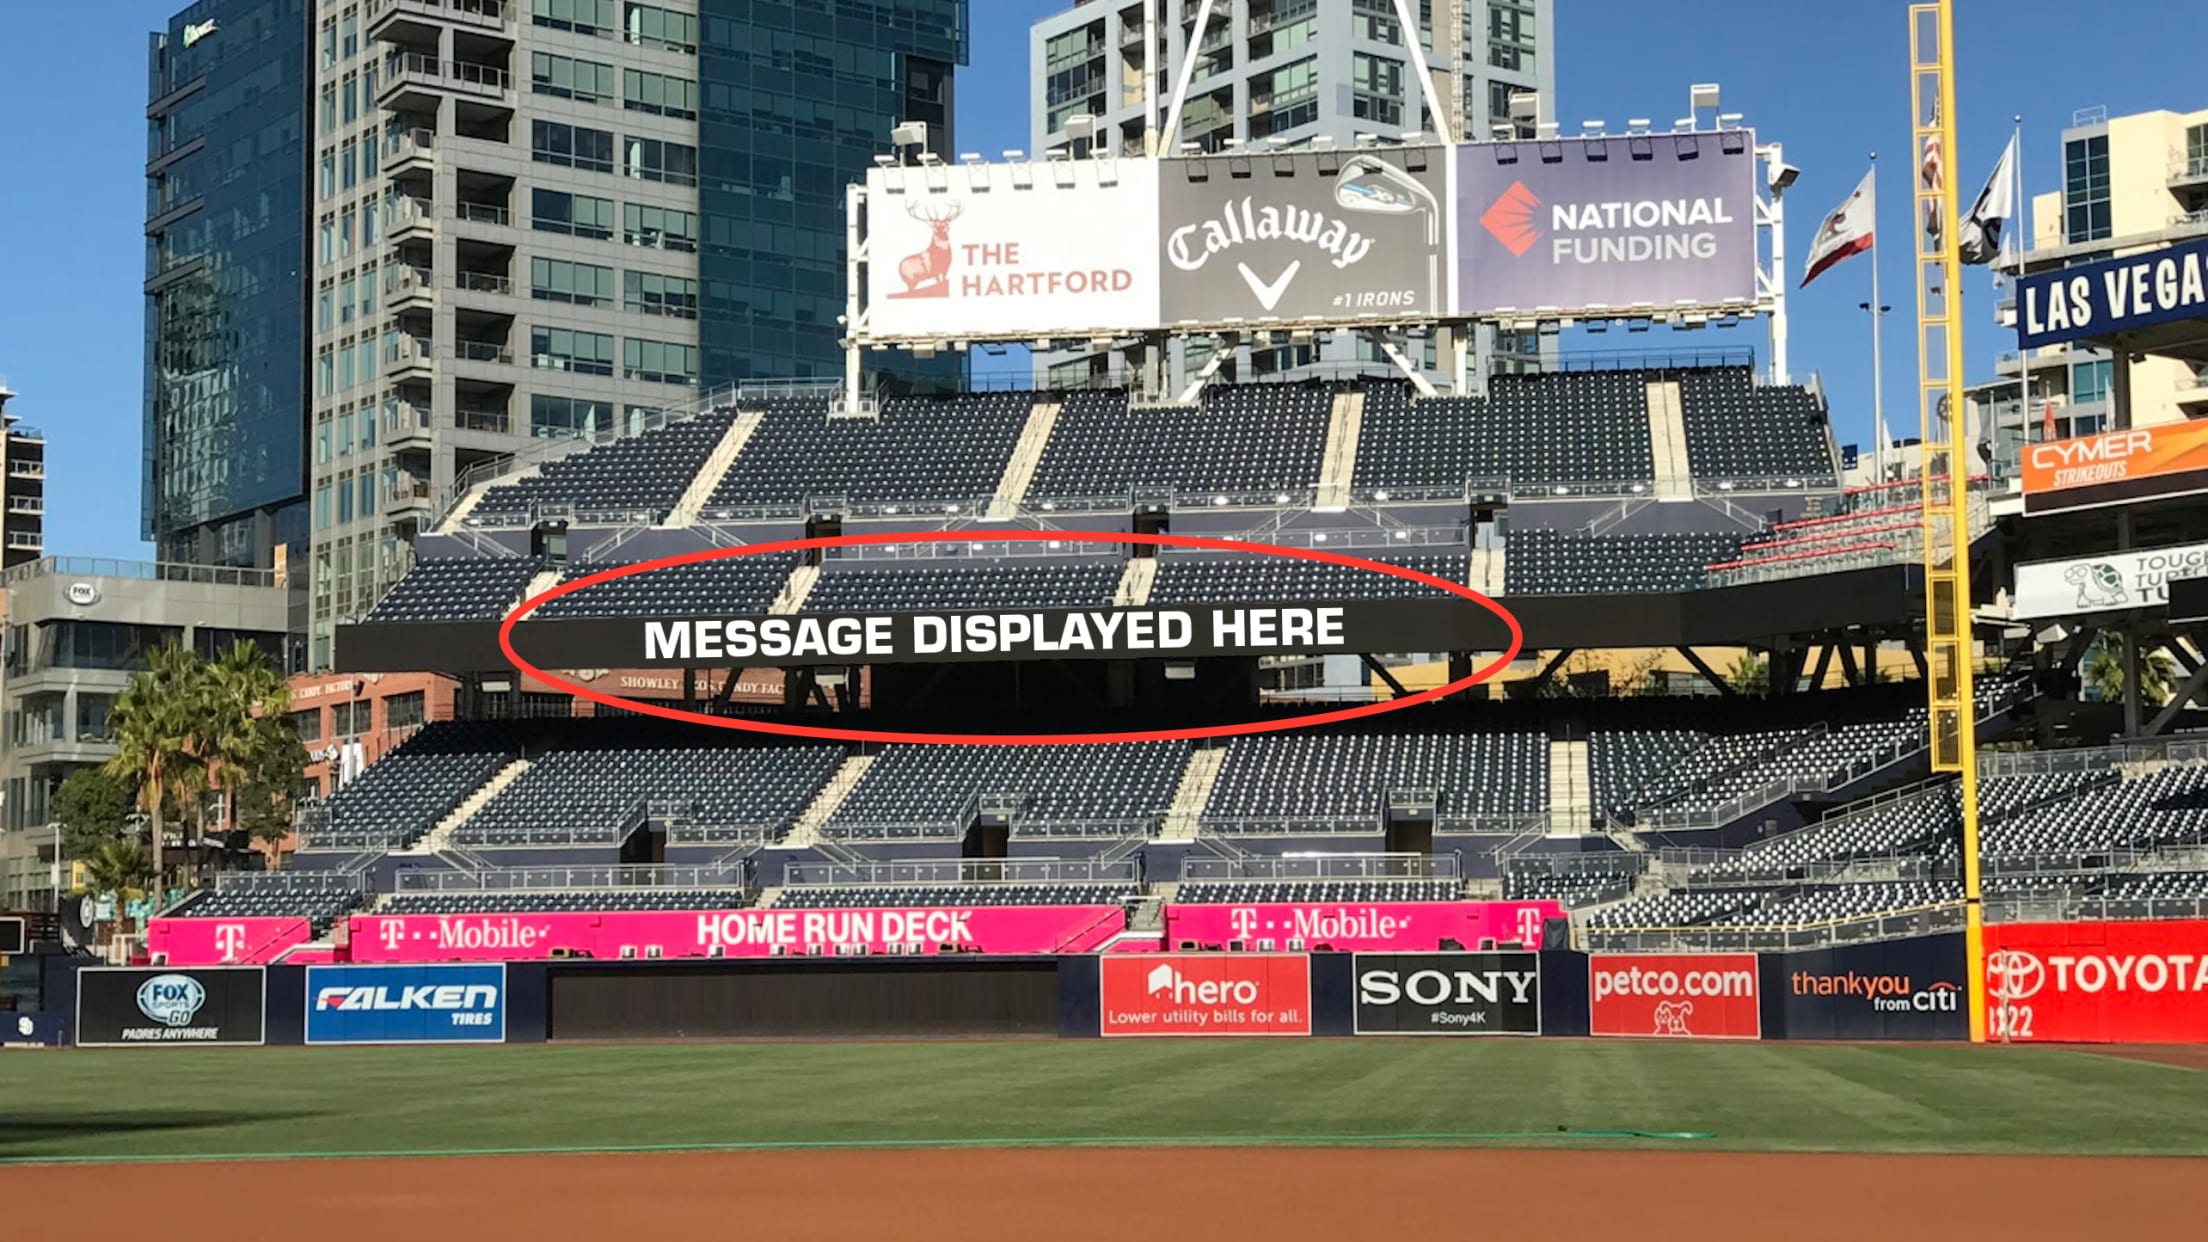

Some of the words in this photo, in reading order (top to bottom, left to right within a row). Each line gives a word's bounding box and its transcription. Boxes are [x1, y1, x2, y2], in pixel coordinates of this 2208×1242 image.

[1553, 197, 1733, 231] NATIONAL
[1168, 195, 1373, 269] Callaway
[962, 243, 1019, 266] THE
[1553, 232, 1717, 265] FUNDING
[962, 269, 1132, 297] HARTFORD
[2026, 276, 2092, 335] LAS
[2104, 253, 2208, 319] VEGA
[1333, 293, 1351, 308] #1
[1357, 291, 1415, 308] IRONS
[2032, 431, 2152, 469] CYMER
[2054, 460, 2127, 487] STRIKEOUTS
[621, 676, 679, 690] SHOWLEY
[698, 914, 796, 944] HOME
[804, 912, 873, 943] RUN
[882, 911, 973, 941] DECK
[153, 984, 188, 1001] FOX
[1174, 971, 1257, 1004] hero
[1360, 970, 1536, 1005] SONY
[1595, 966, 1753, 1001] petco.com
[1874, 996, 1910, 1011] from
[1912, 983, 1957, 1011] citi
[152, 1001, 190, 1009] SPORTS
[315, 985, 498, 1011] FALKEN
[168, 1010, 190, 1024] GO
[452, 1012, 492, 1025] TIRES
[1109, 1010, 1157, 1024] Lower
[1163, 1009, 1208, 1026] utility
[1214, 1010, 1245, 1023] bills
[1251, 1009, 1275, 1023] for
[1280, 1009, 1302, 1023] all.
[1431, 1011, 1486, 1026] #Sony4K
[122, 1028, 161, 1040] PADRES
[162, 1027, 219, 1040] ANYWHERE
